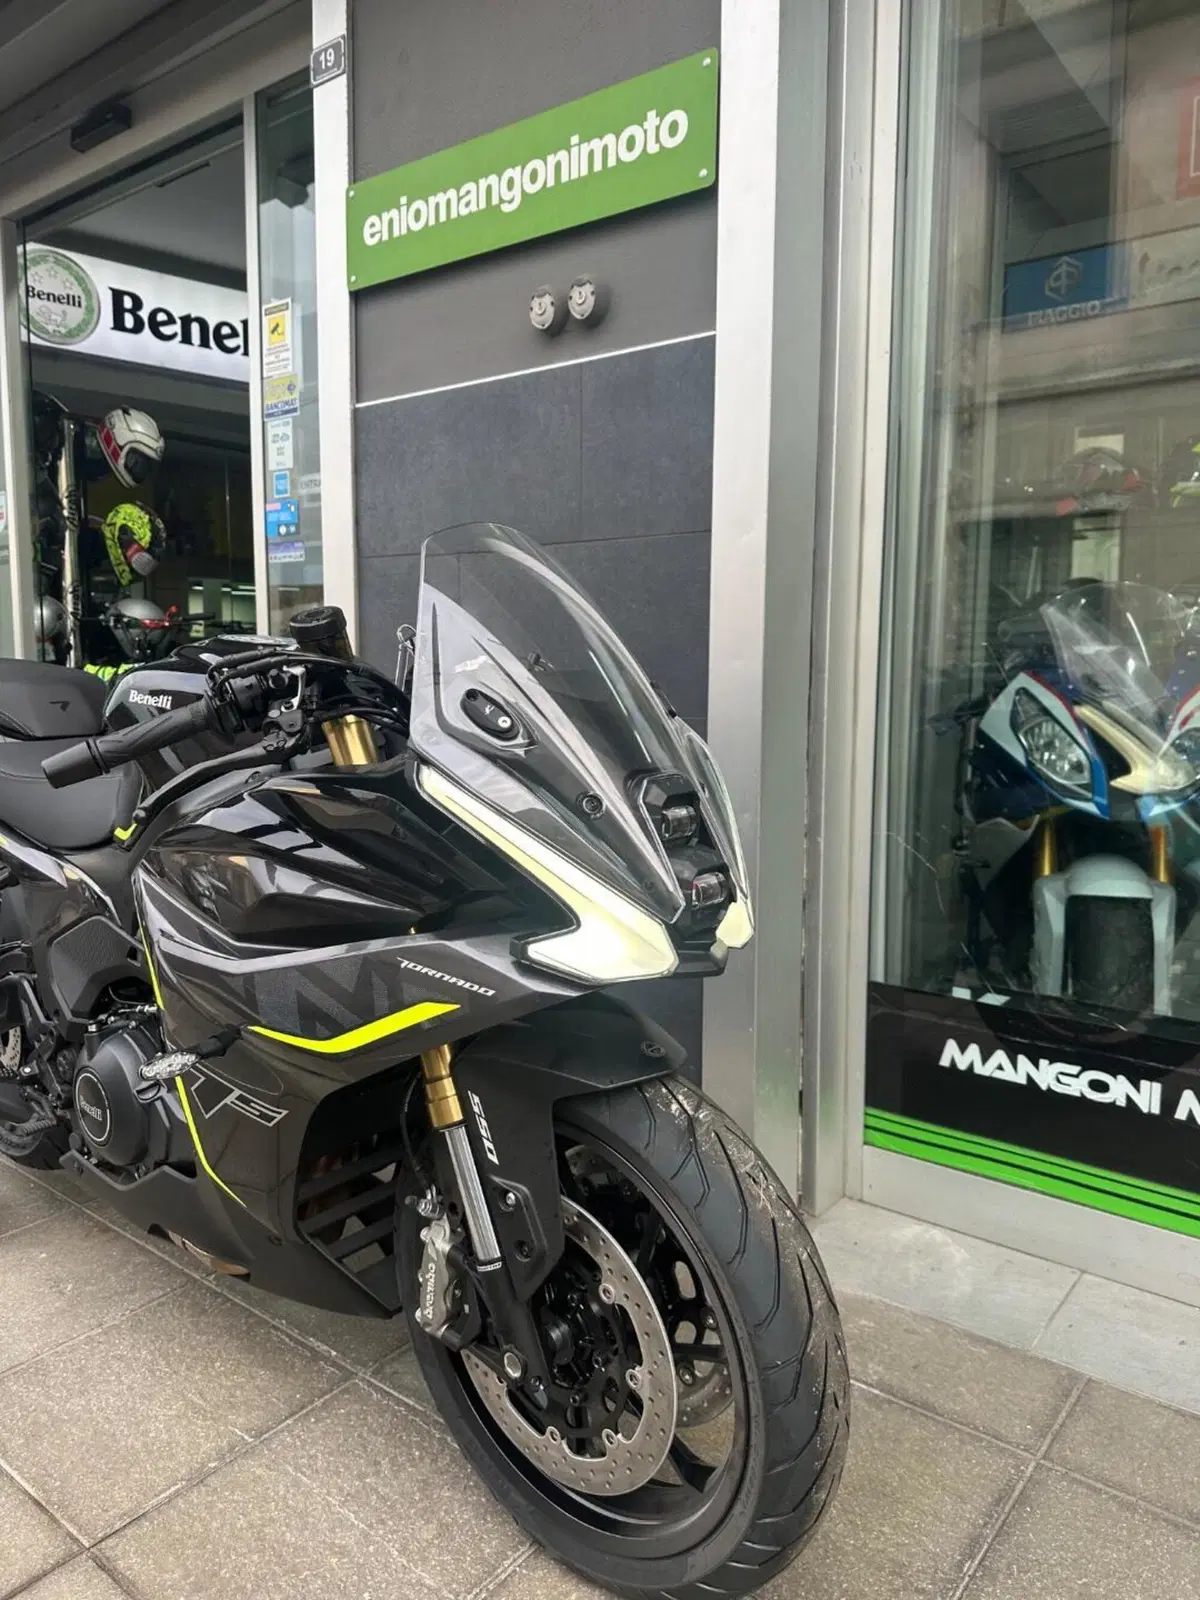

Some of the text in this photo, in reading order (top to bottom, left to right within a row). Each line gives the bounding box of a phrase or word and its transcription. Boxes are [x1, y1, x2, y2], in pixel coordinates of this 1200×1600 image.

[319, 48, 335, 69] 19
[362, 108, 689, 248] eniomangonimoto
[27, 285, 82, 309] Benelli
[128, 689, 173, 711] Benelli
[396, 956, 497, 997] TORNADO
[938, 1037, 1163, 1116] MANGONI
[466, 1089, 500, 1166] 550
[420, 1261, 437, 1320] brembo
